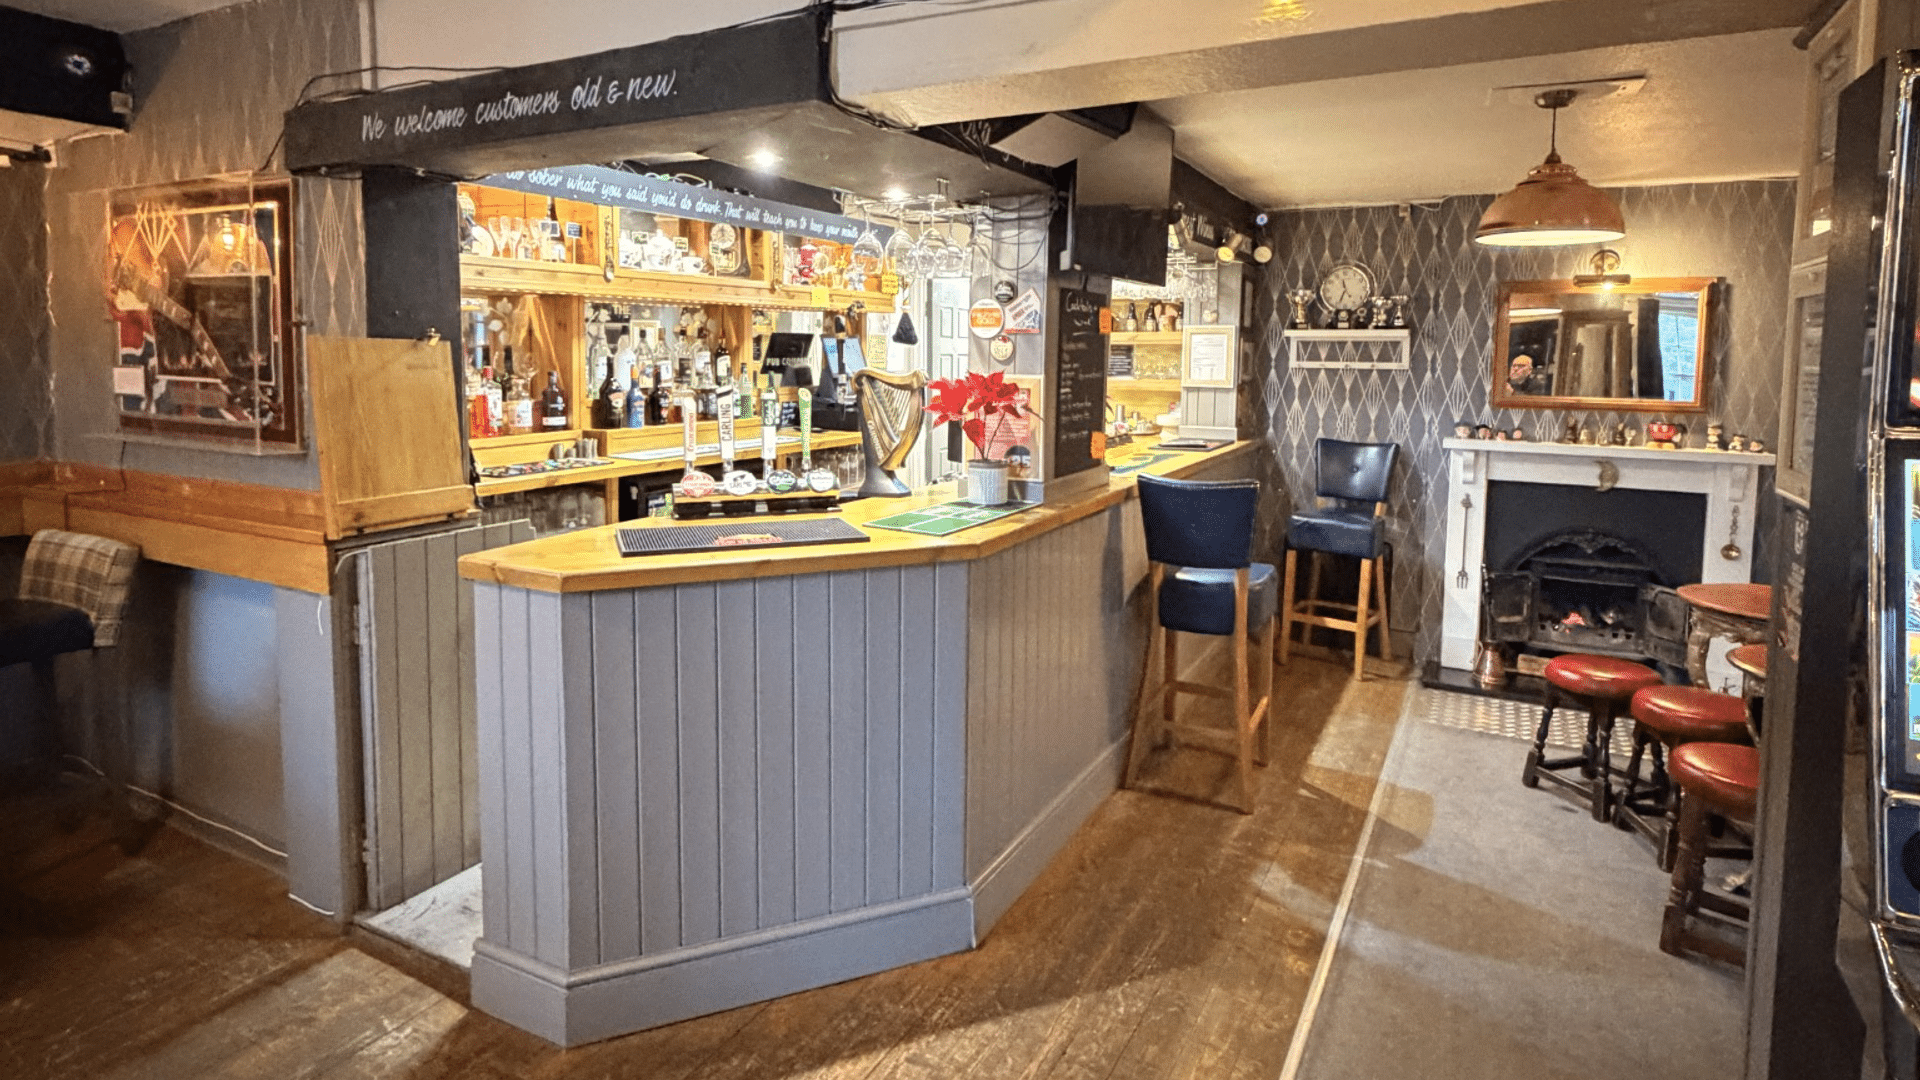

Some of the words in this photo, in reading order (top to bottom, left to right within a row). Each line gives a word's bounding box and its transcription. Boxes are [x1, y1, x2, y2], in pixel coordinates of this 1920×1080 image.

[361, 114, 386, 141] We
[394, 105, 468, 137] welcome
[475, 90, 559, 124] customers
[571, 76, 602, 111] old
[607, 80, 623, 104] &
[626, 70, 678, 103] new.
[528, 168, 563, 187] sober
[566, 174, 599, 194] what
[601, 183, 622, 200] you
[625, 184, 648, 202] said
[680, 193, 692, 211] do
[724, 201, 744, 218] That
[745, 207, 761, 222] will
[720, 403, 733, 442] CARLING
